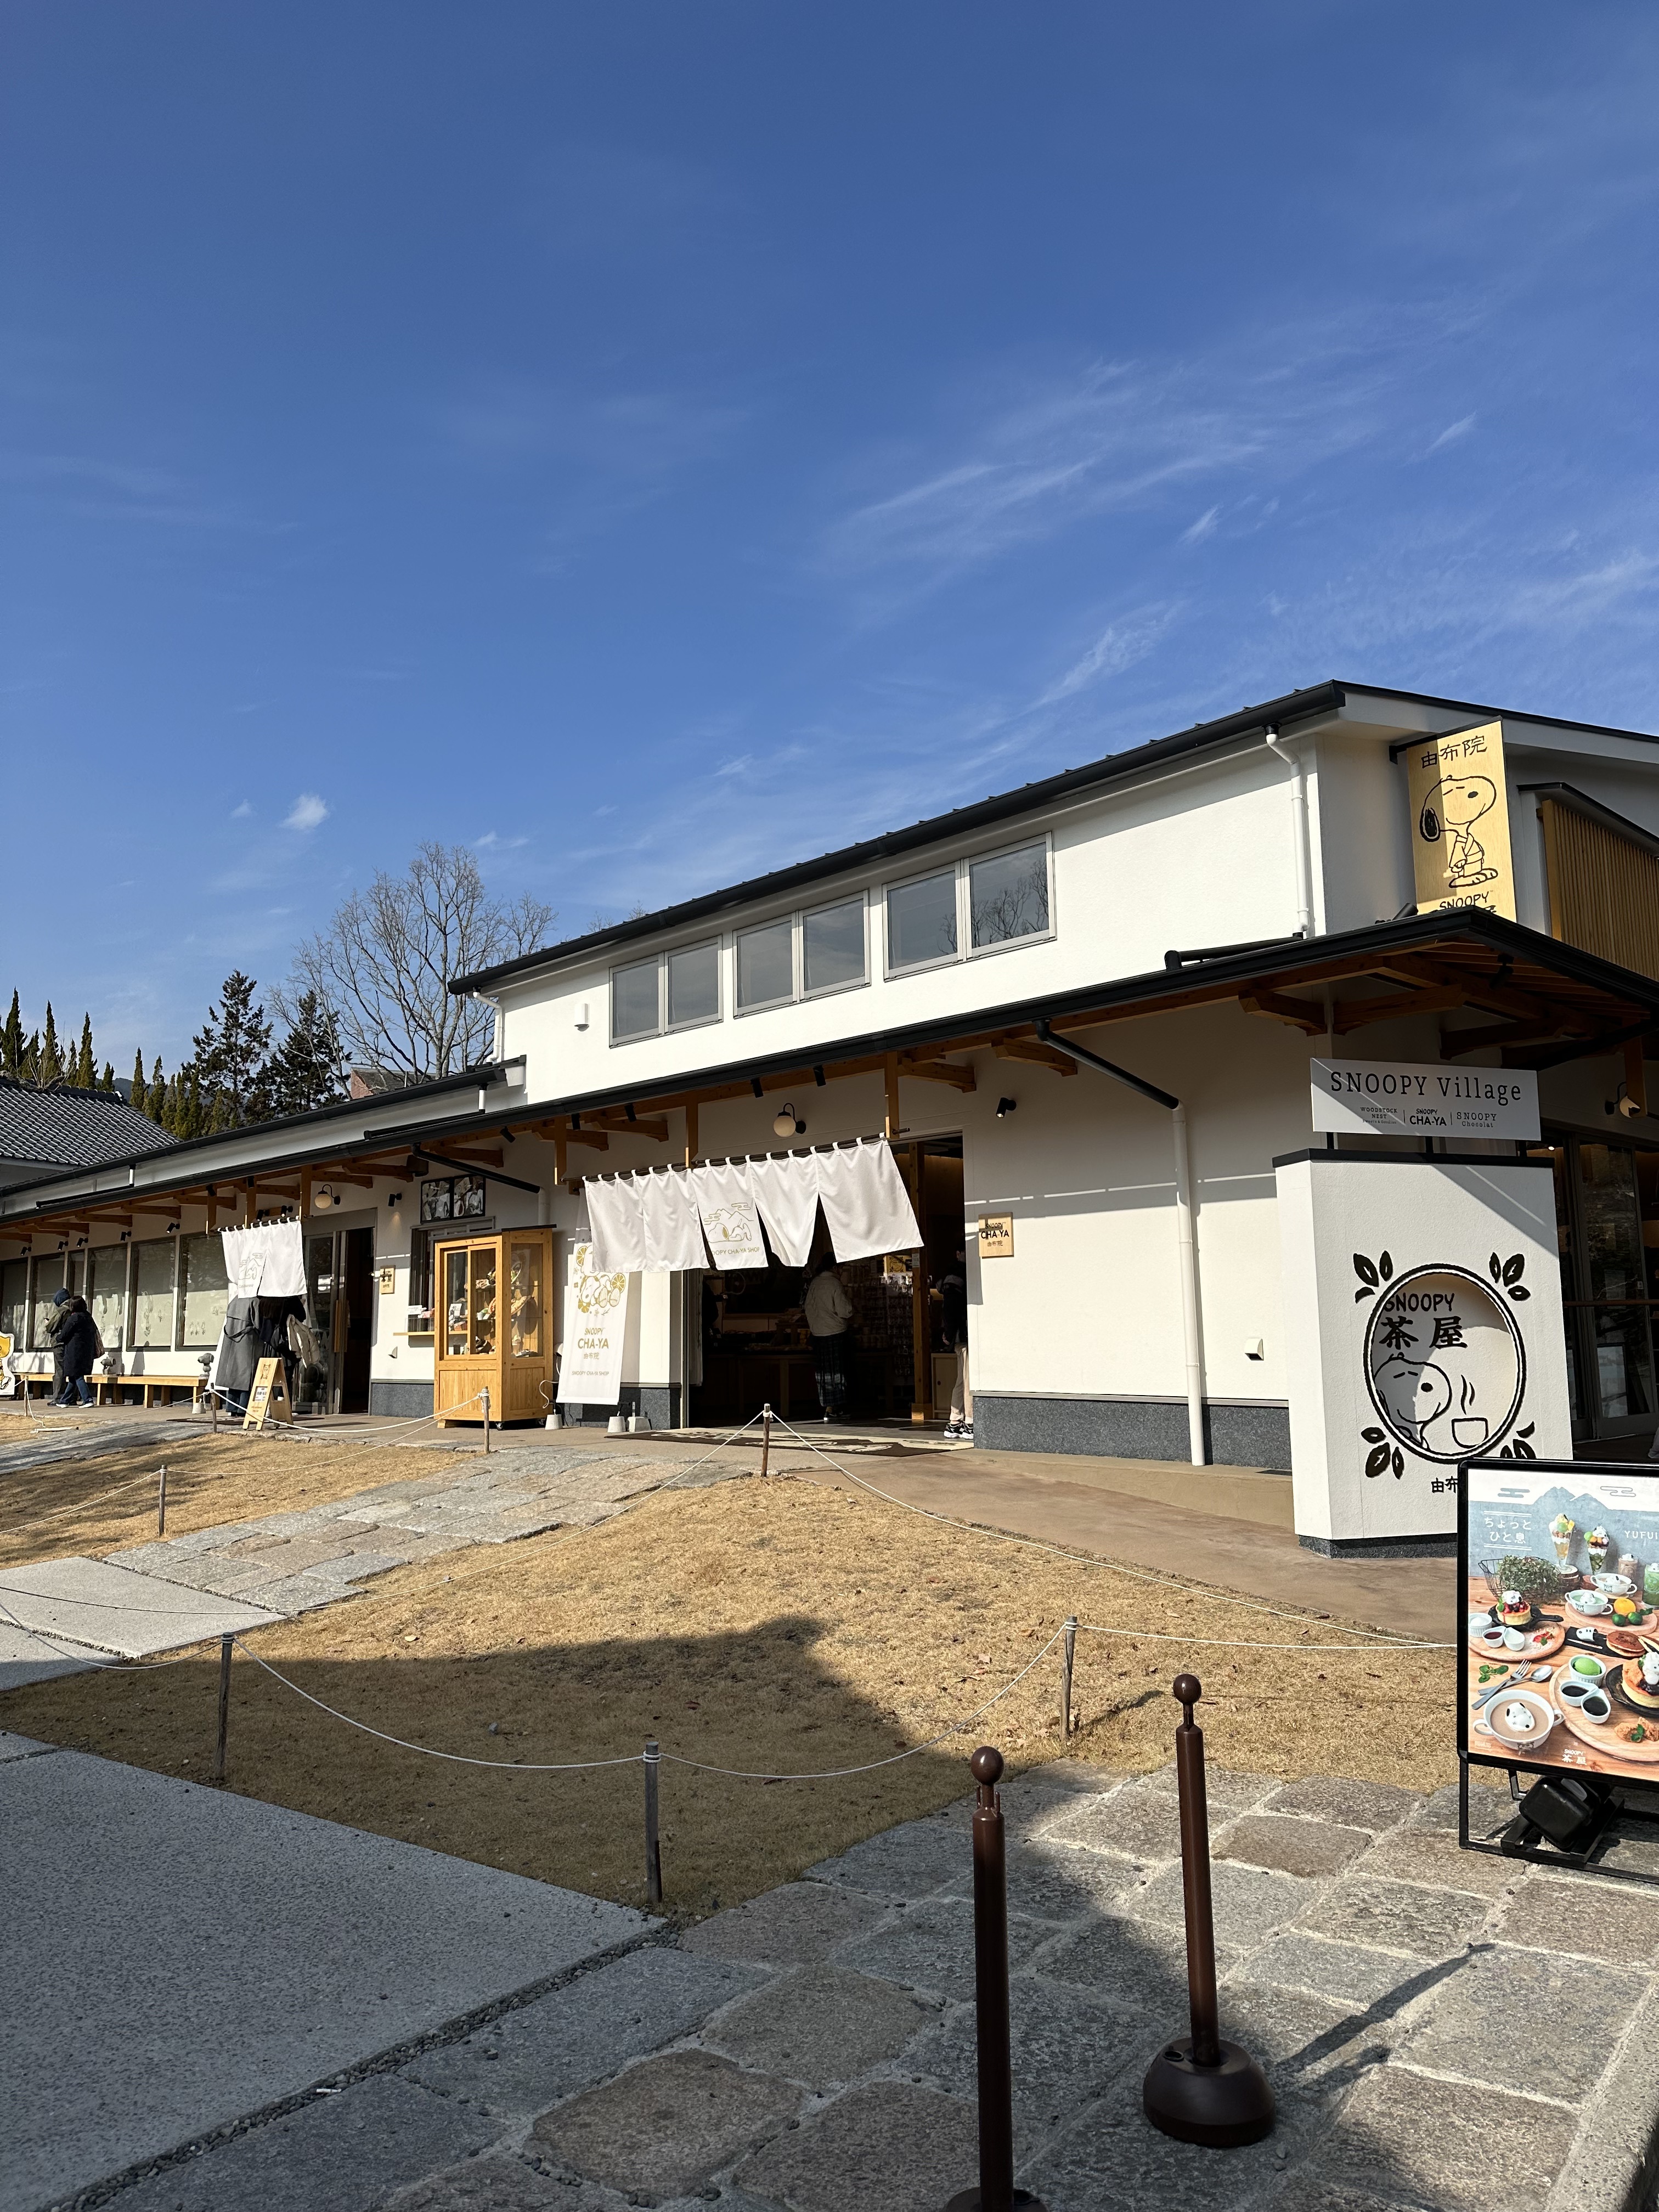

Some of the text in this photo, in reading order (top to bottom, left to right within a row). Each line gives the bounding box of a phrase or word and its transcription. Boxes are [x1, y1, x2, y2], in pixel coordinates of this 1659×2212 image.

[1421, 736, 1487, 769] 由布院
[1440, 891, 1489, 910] SNOOPY
[1330, 1071, 1521, 1106] SNOOPY Village
[1409, 1115, 1447, 1126] CHA-YA
[1457, 1112, 1497, 1121] SNOOPY
[981, 1229, 1009, 1239] CHA-YA
[1384, 1293, 1455, 1312] SNOOPY
[1379, 1316, 1468, 1350] 茶屋
[578, 1338, 609, 1349] CHA-YA
[1485, 1517, 1531, 1530] ちょっと
[1489, 1532, 1526, 1544] ひと息
[1624, 1530, 1658, 1539] YUFUI
